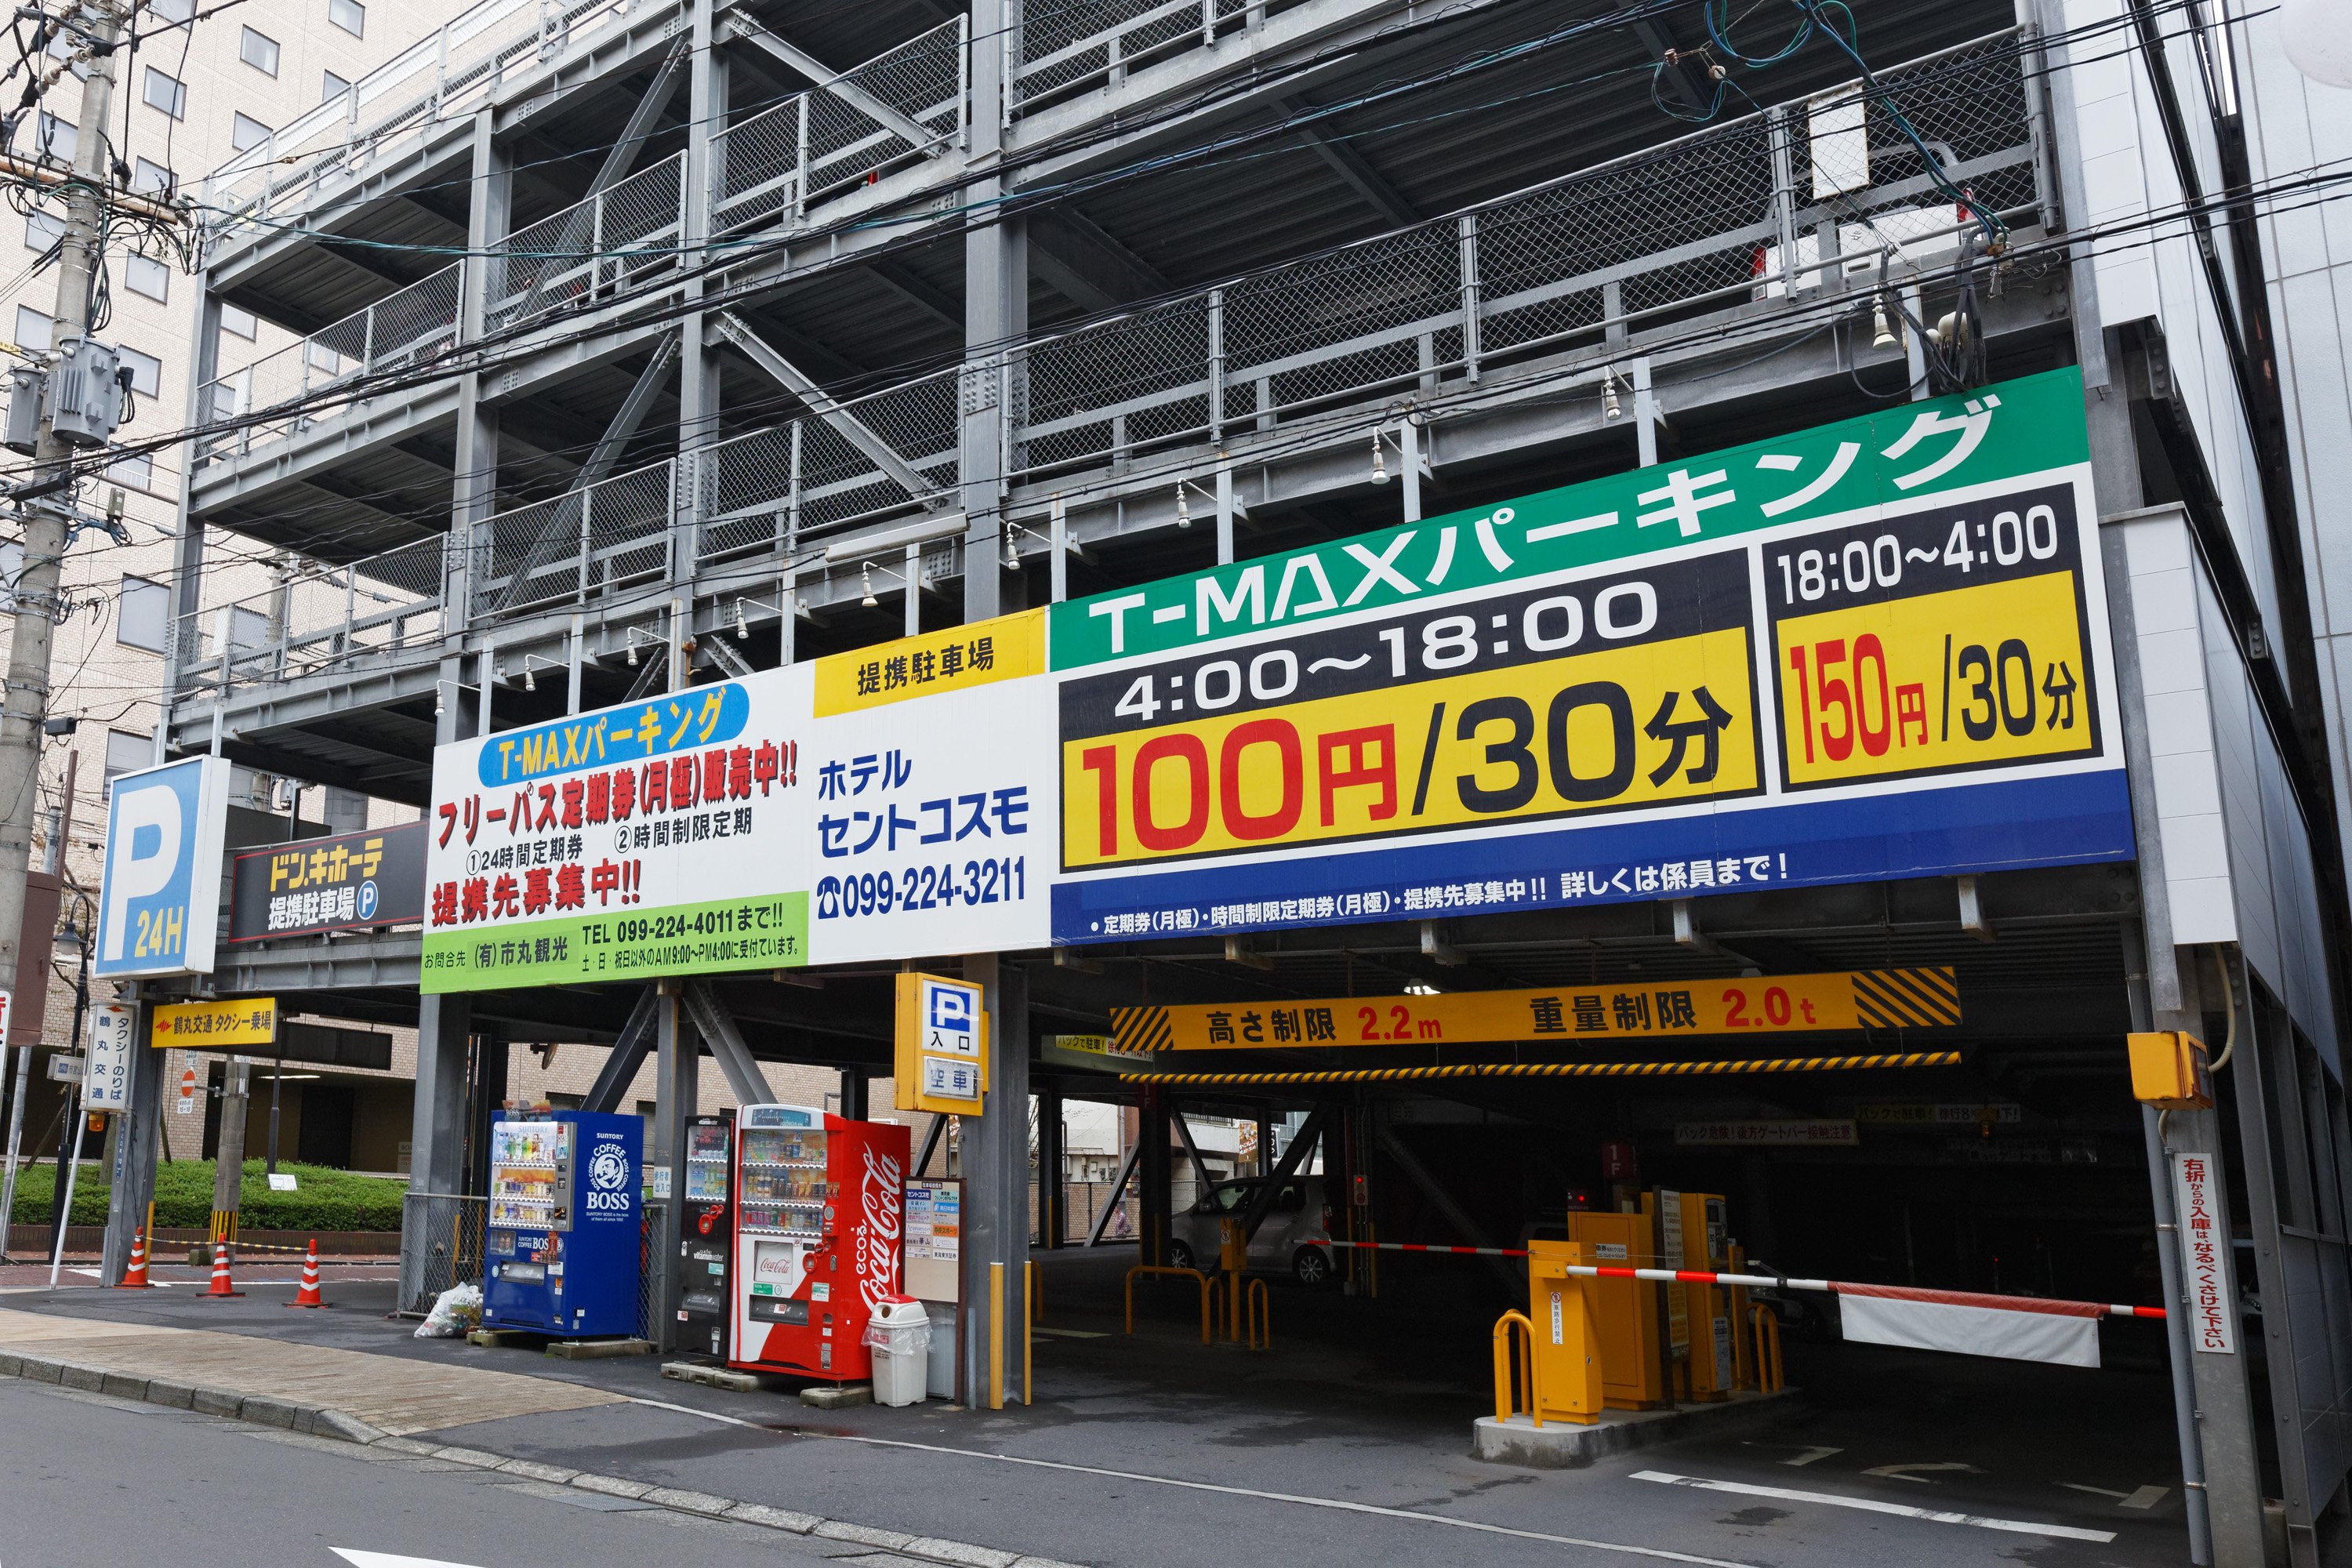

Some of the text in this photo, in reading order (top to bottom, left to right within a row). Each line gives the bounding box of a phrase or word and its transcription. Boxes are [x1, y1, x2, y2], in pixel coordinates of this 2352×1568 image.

[1089, 394, 2002, 654] T-MAXパーキング
[858, 637, 994, 696] 提携駐車場
[499, 686, 726, 779] T-MAXパーキング
[818, 750, 912, 800] ホテル
[818, 786, 1029, 858] セントコスモ
[432, 858, 641, 927] 提携先募集中!!
[1561, 853, 1787, 898] 詳しくは係員まで!
[268, 887, 354, 930] 提携駐車場
[134, 906, 183, 958] 24H
[424, 935, 568, 969] お問合先 (有)市丸観光
[582, 924, 611, 945] TEL
[173, 1011, 271, 1036] 鶴丸交通 タクシー乗場
[937, 992, 964, 1026] P
[1206, 986, 1817, 1044] 高さ制限 2.2m 重量制限 2.0t
[92, 1016, 111, 1099] 鶴丸交通
[111, 1018, 129, 1100] タクシーのりば
[931, 1031, 970, 1051] 入口
[931, 1068, 967, 1091] 空車
[593, 1143, 626, 1159] COFFEE
[655, 1171, 669, 1181] 歩行者
[655, 1183, 670, 1192] 出入口
[586, 1192, 630, 1210] BOSS
[2183, 1158, 2225, 1348] 右折からの入庫は、なるべくさけて下さい
